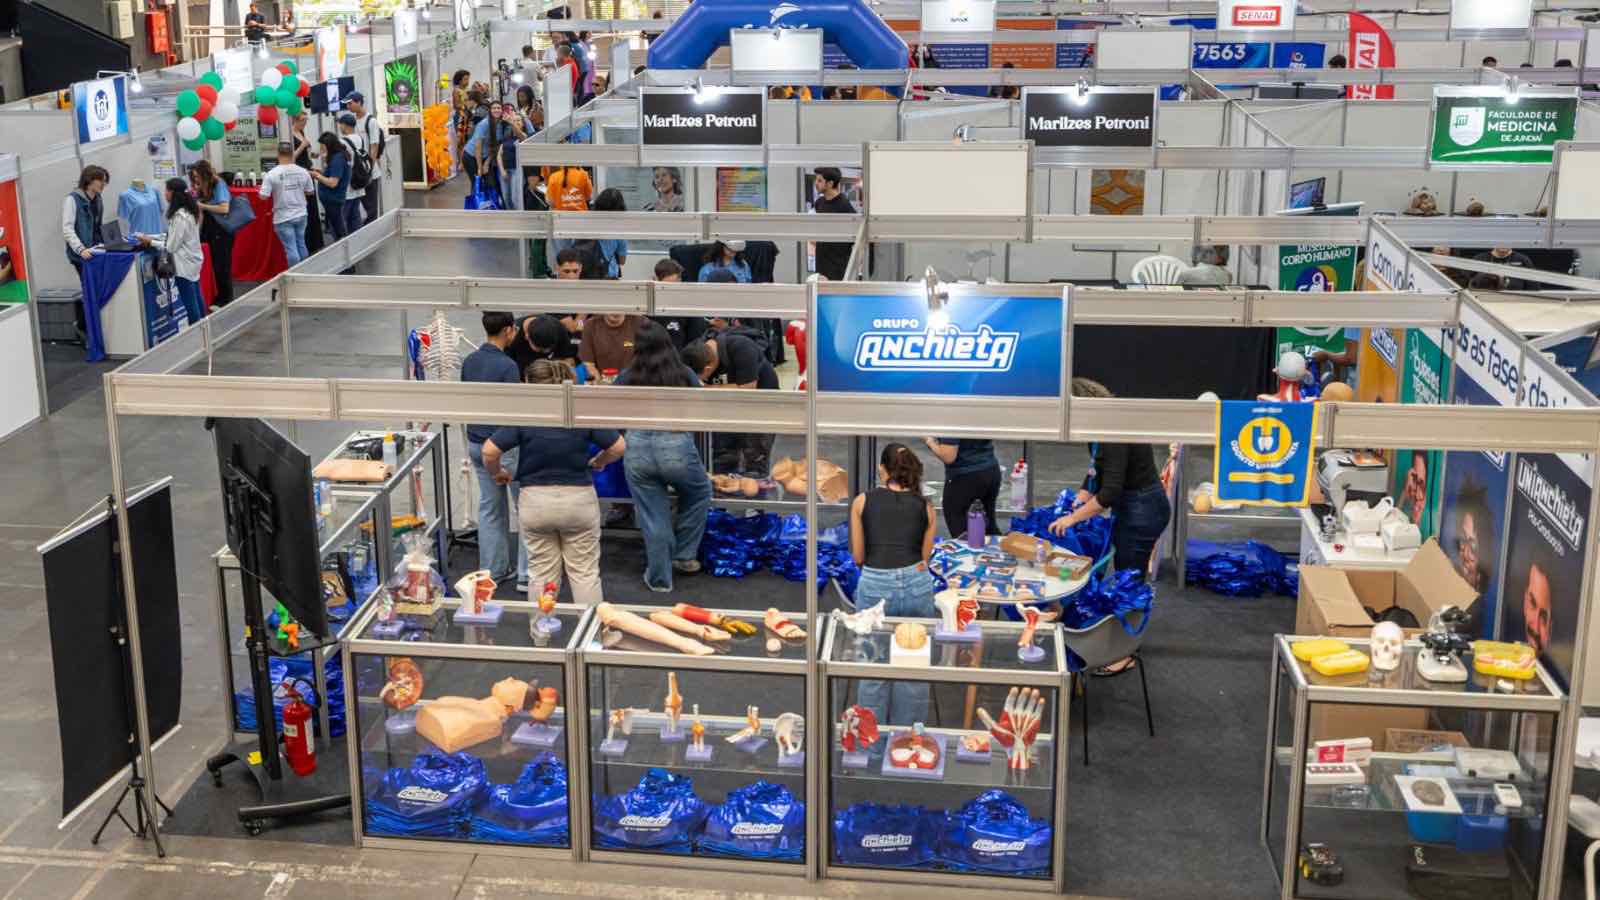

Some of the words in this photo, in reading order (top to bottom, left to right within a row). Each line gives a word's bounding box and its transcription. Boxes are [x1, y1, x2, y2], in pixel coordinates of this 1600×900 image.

[643, 113, 703, 128] Marilzes
[705, 113, 757, 128] Petroni
[1029, 116, 1092, 130] Marilzes
[1095, 115, 1150, 129] Petroni
[1488, 111, 1542, 119] FACULDADE
[1545, 111, 1558, 119] DE
[1487, 121, 1558, 132] MEDICINA
[1281, 253, 1312, 266] CORPO
[1312, 247, 1352, 263] HUMANO
[873, 318, 919, 329] GRUPO
[1471, 333, 1487, 367] as
